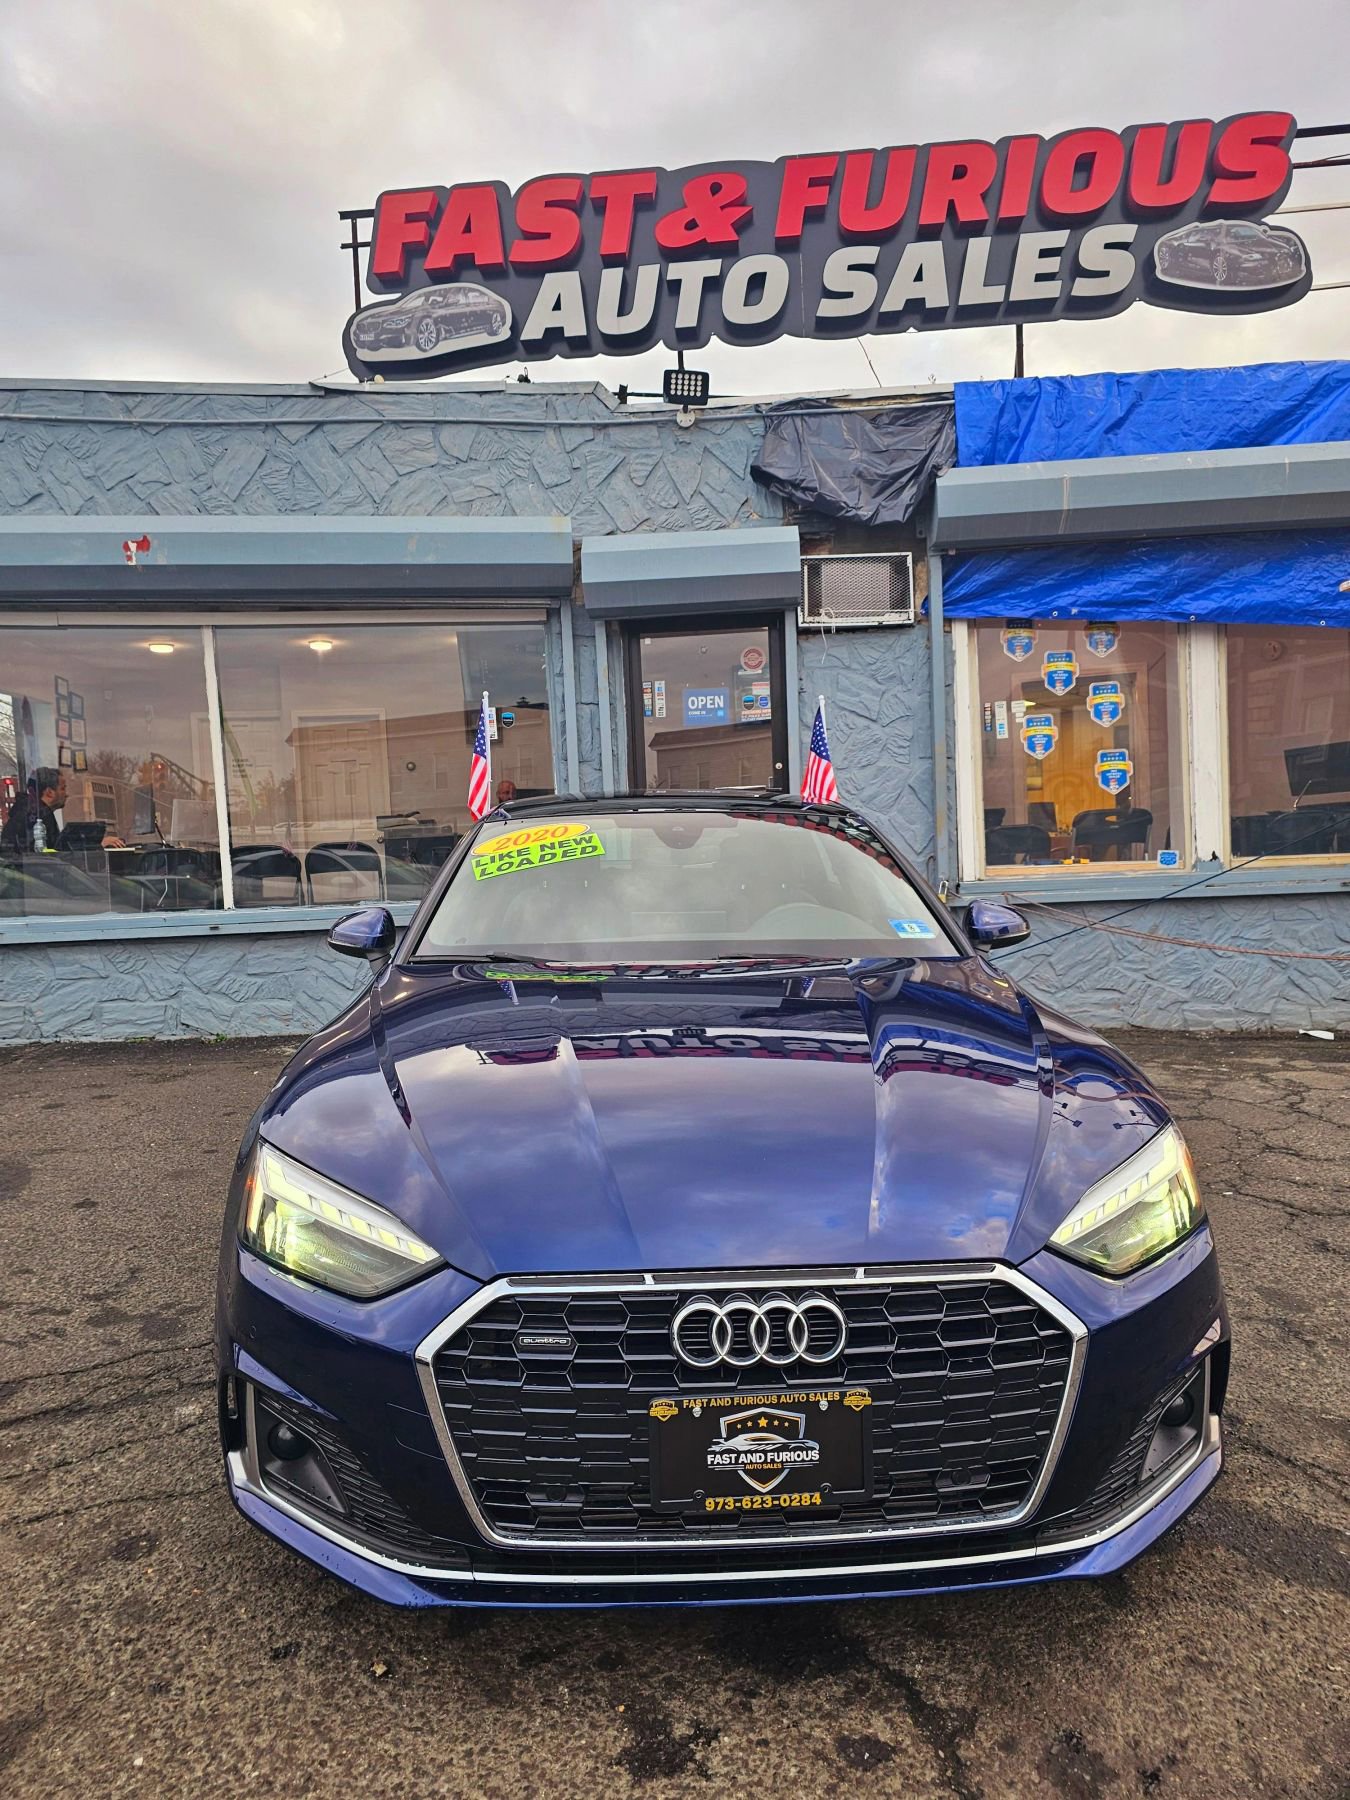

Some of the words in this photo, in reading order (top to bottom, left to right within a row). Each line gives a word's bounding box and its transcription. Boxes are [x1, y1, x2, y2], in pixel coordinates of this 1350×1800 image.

[372, 172, 657, 277] FAST
[655, 172, 753, 253] &
[774, 112, 1294, 243] FURIOUS
[519, 254, 790, 342] AUTO
[815, 224, 1139, 318] SALES
[688, 695, 724, 709] OPEN
[475, 846, 531, 868] LIKE
[539, 835, 594, 853] NEW
[493, 825, 569, 852] 2020
[479, 845, 599, 878] LOADED
[683, 1398, 708, 1409] FAST
[709, 1397, 732, 1407] AND
[733, 1395, 778, 1406] FURIOUS
[780, 1393, 807, 1404] AUTO
[809, 1391, 840, 1402] SALES
[707, 1453, 737, 1465] FAST
[738, 1452, 765, 1463] AND
[766, 1450, 820, 1462] FURIOUS
[705, 1491, 822, 1512] 973-623-0284
